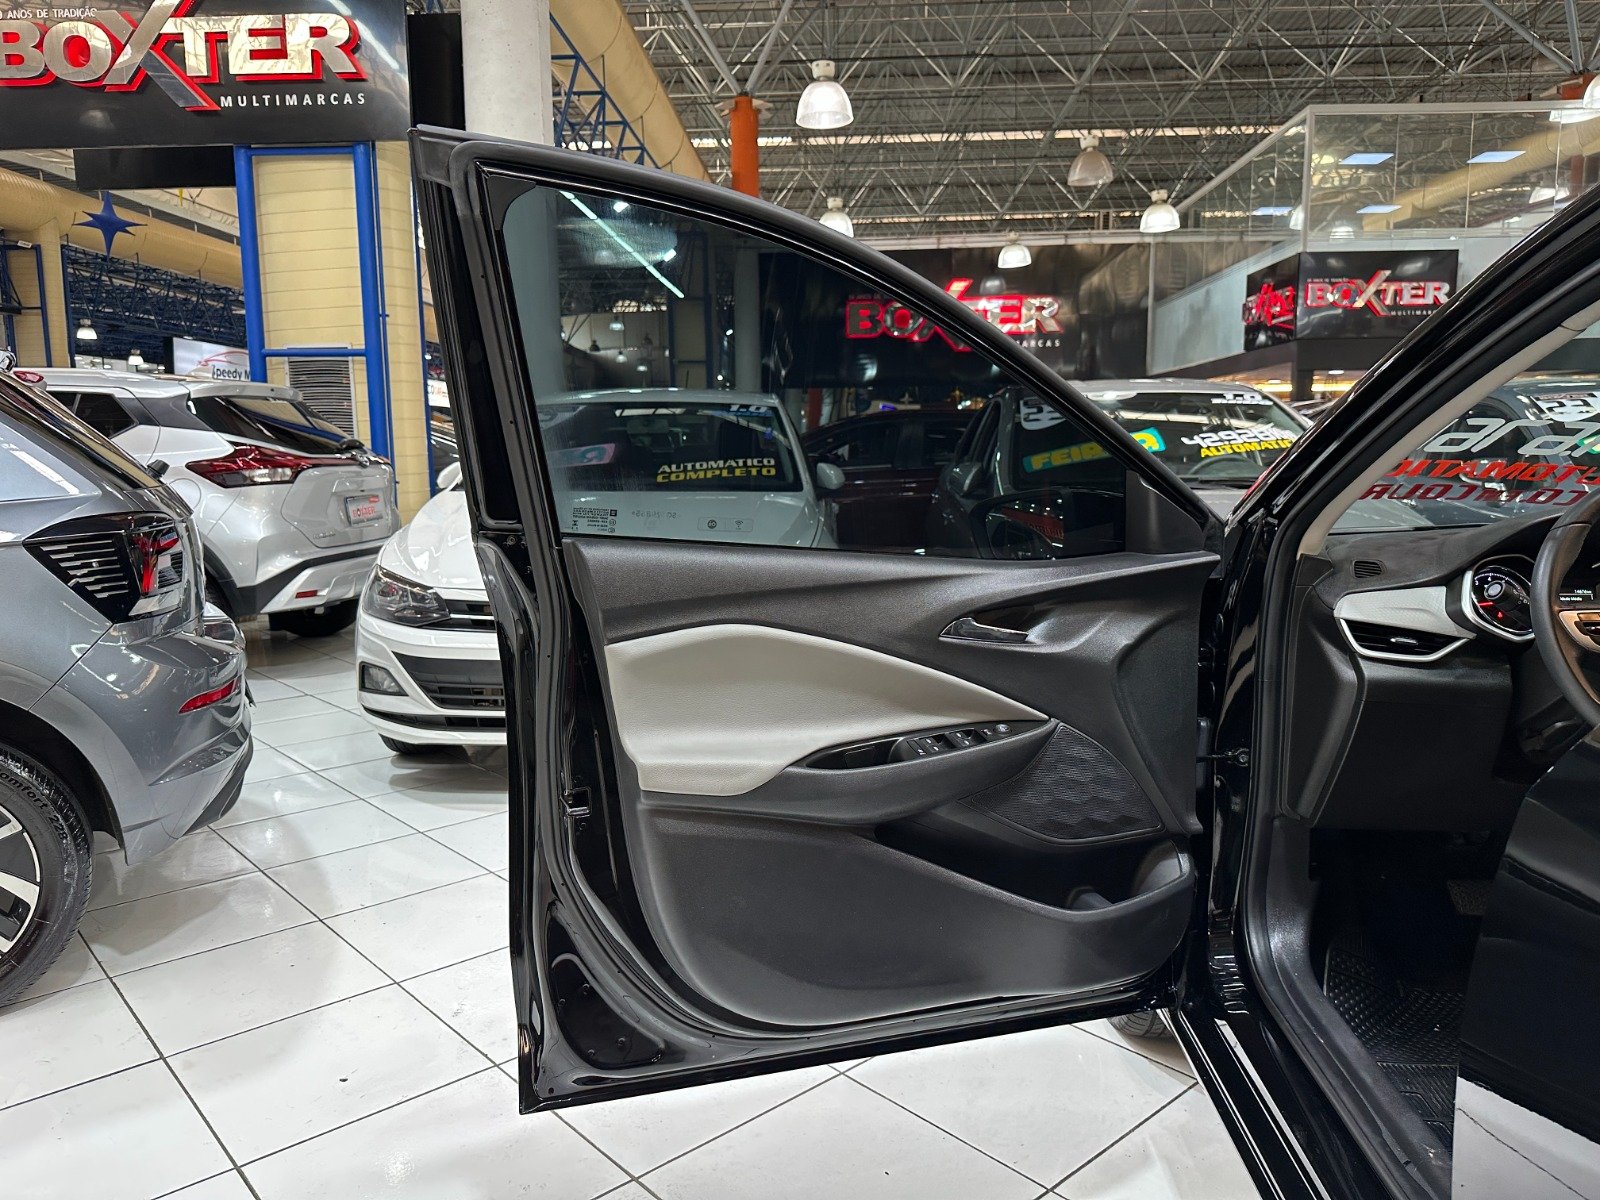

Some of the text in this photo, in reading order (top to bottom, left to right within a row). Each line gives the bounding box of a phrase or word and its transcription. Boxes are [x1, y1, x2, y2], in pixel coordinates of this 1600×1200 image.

[7, 9, 32, 19] ANOS
[37, 9, 49, 18] DE
[52, 6, 97, 19] TRADIÇÃO
[0, 0, 364, 111] BOXTER
[220, 93, 366, 108] MULTIMARCAS
[1305, 270, 1450, 317] BOXTER
[658, 457, 776, 473] AUTOMATICO
[656, 466, 776, 483] COMPLETO
